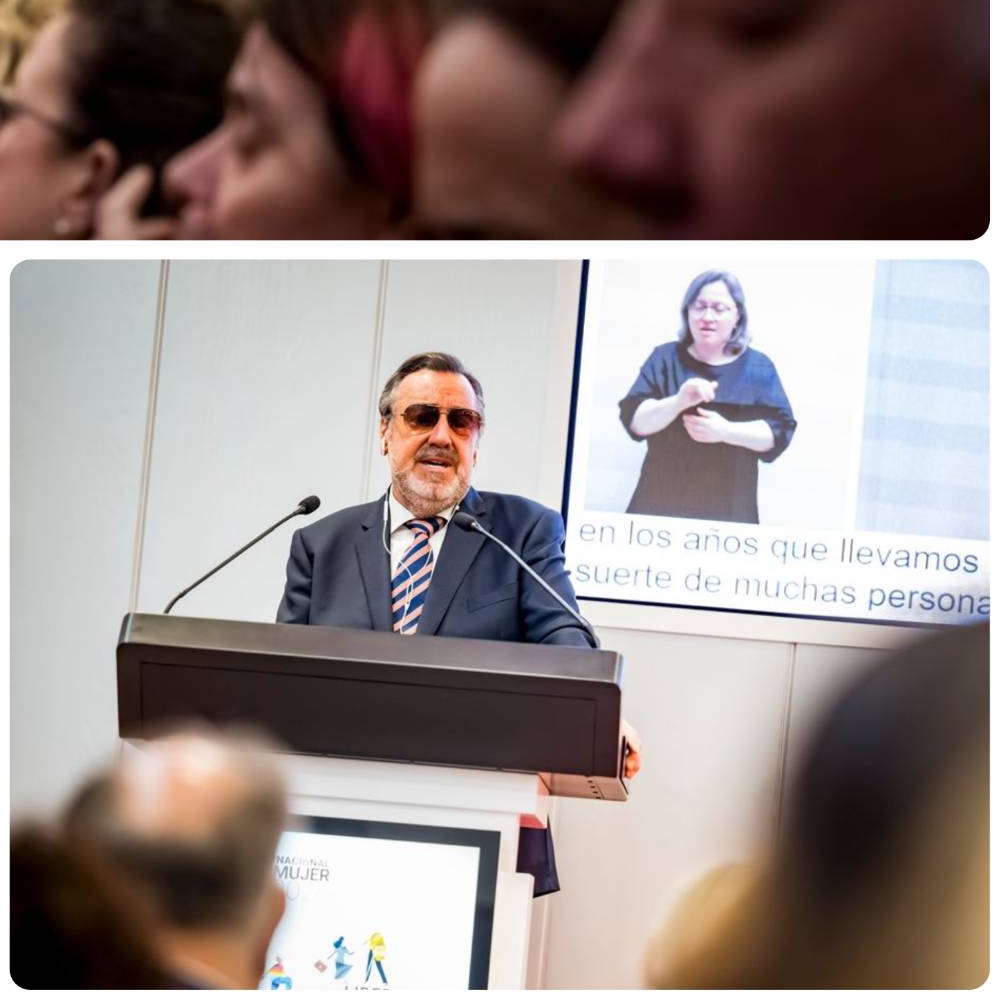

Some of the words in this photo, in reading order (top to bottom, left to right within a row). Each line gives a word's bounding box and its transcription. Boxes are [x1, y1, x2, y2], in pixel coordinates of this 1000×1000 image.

[579, 522, 616, 545] en
[628, 520, 672, 549] los
[683, 527, 759, 556] años
[771, 538, 828, 565] que
[840, 537, 979, 574] llevamos
[575, 562, 672, 589] suerte
[684, 567, 721, 593] de
[734, 575, 856, 605] muchas
[275, 865, 330, 882] MUJER
